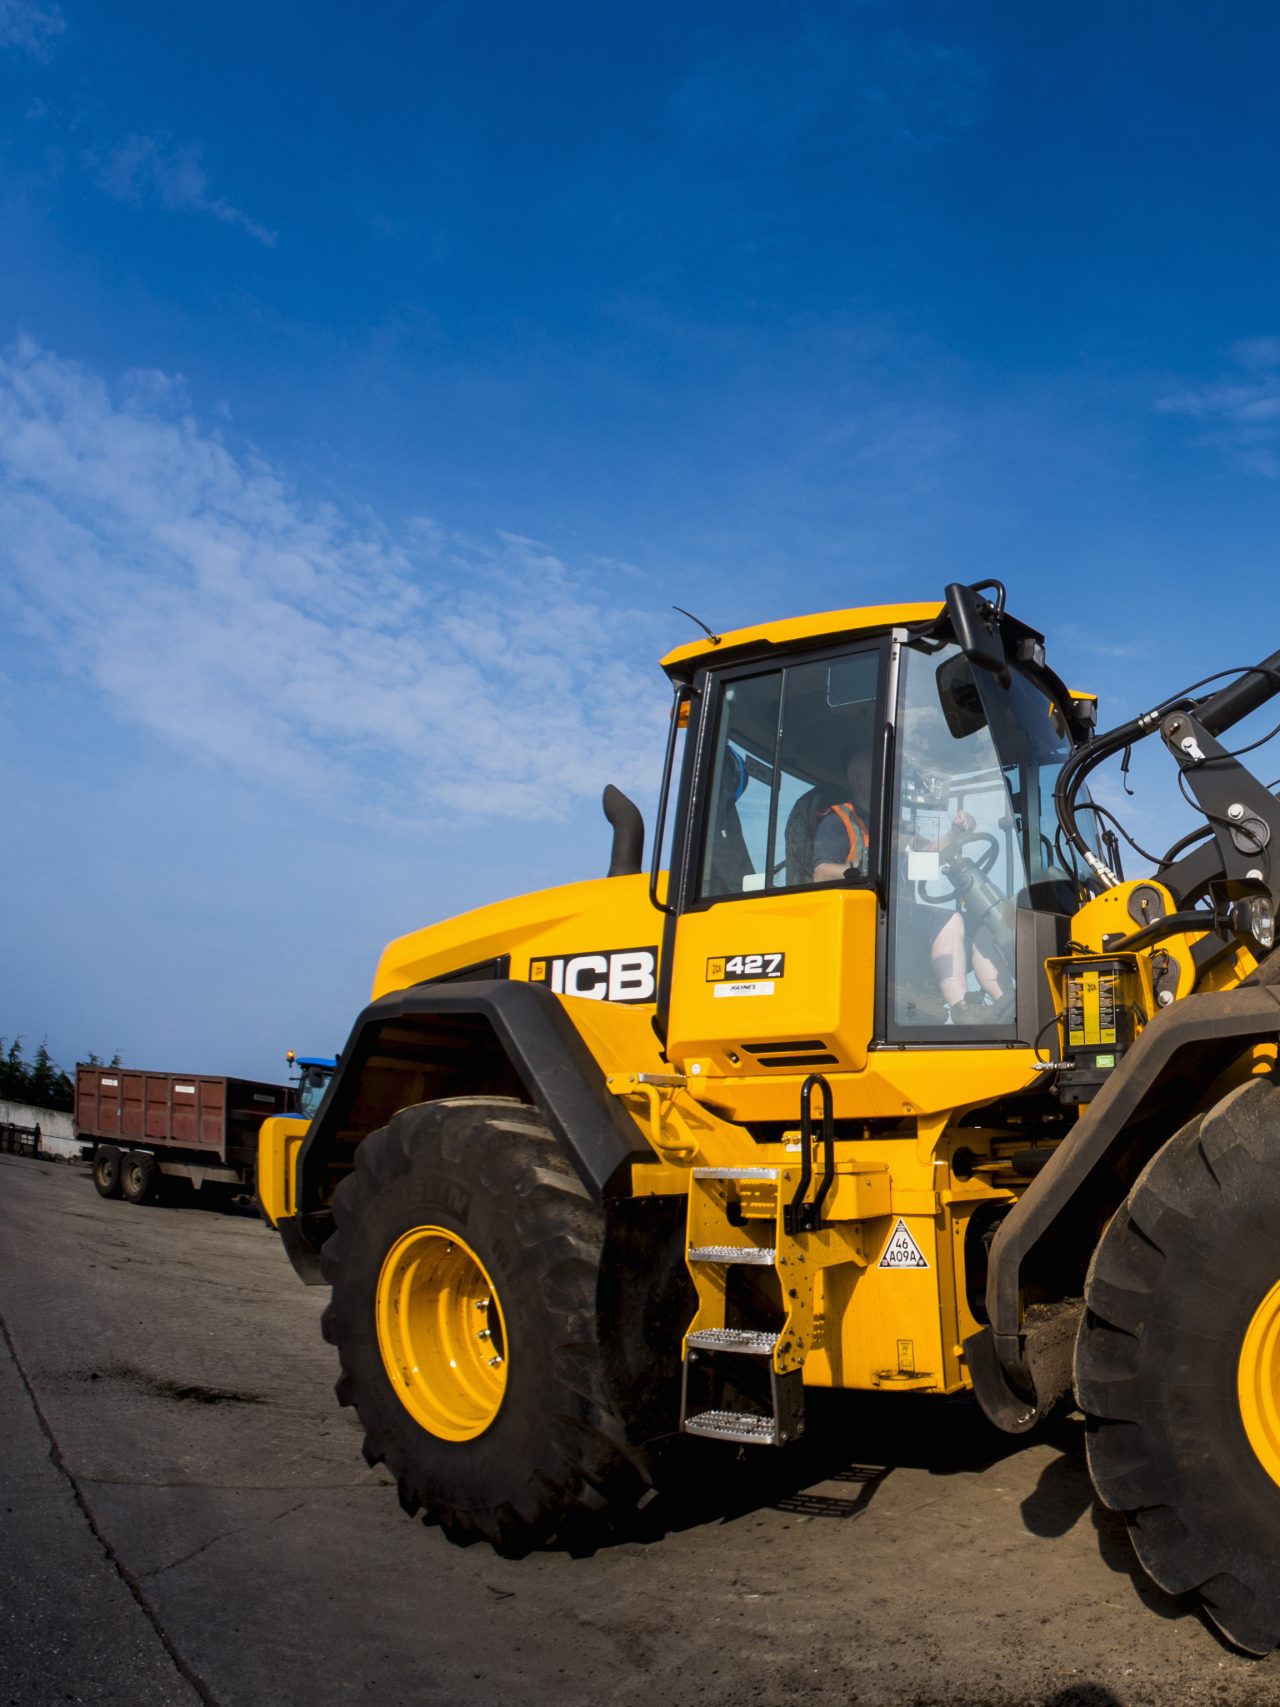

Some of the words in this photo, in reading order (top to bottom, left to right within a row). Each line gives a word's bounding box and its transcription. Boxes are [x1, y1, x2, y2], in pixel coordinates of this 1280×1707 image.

[726, 954, 782, 974] 427
[896, 1238, 908, 1249] 46
[890, 1251, 916, 1262] A09A
